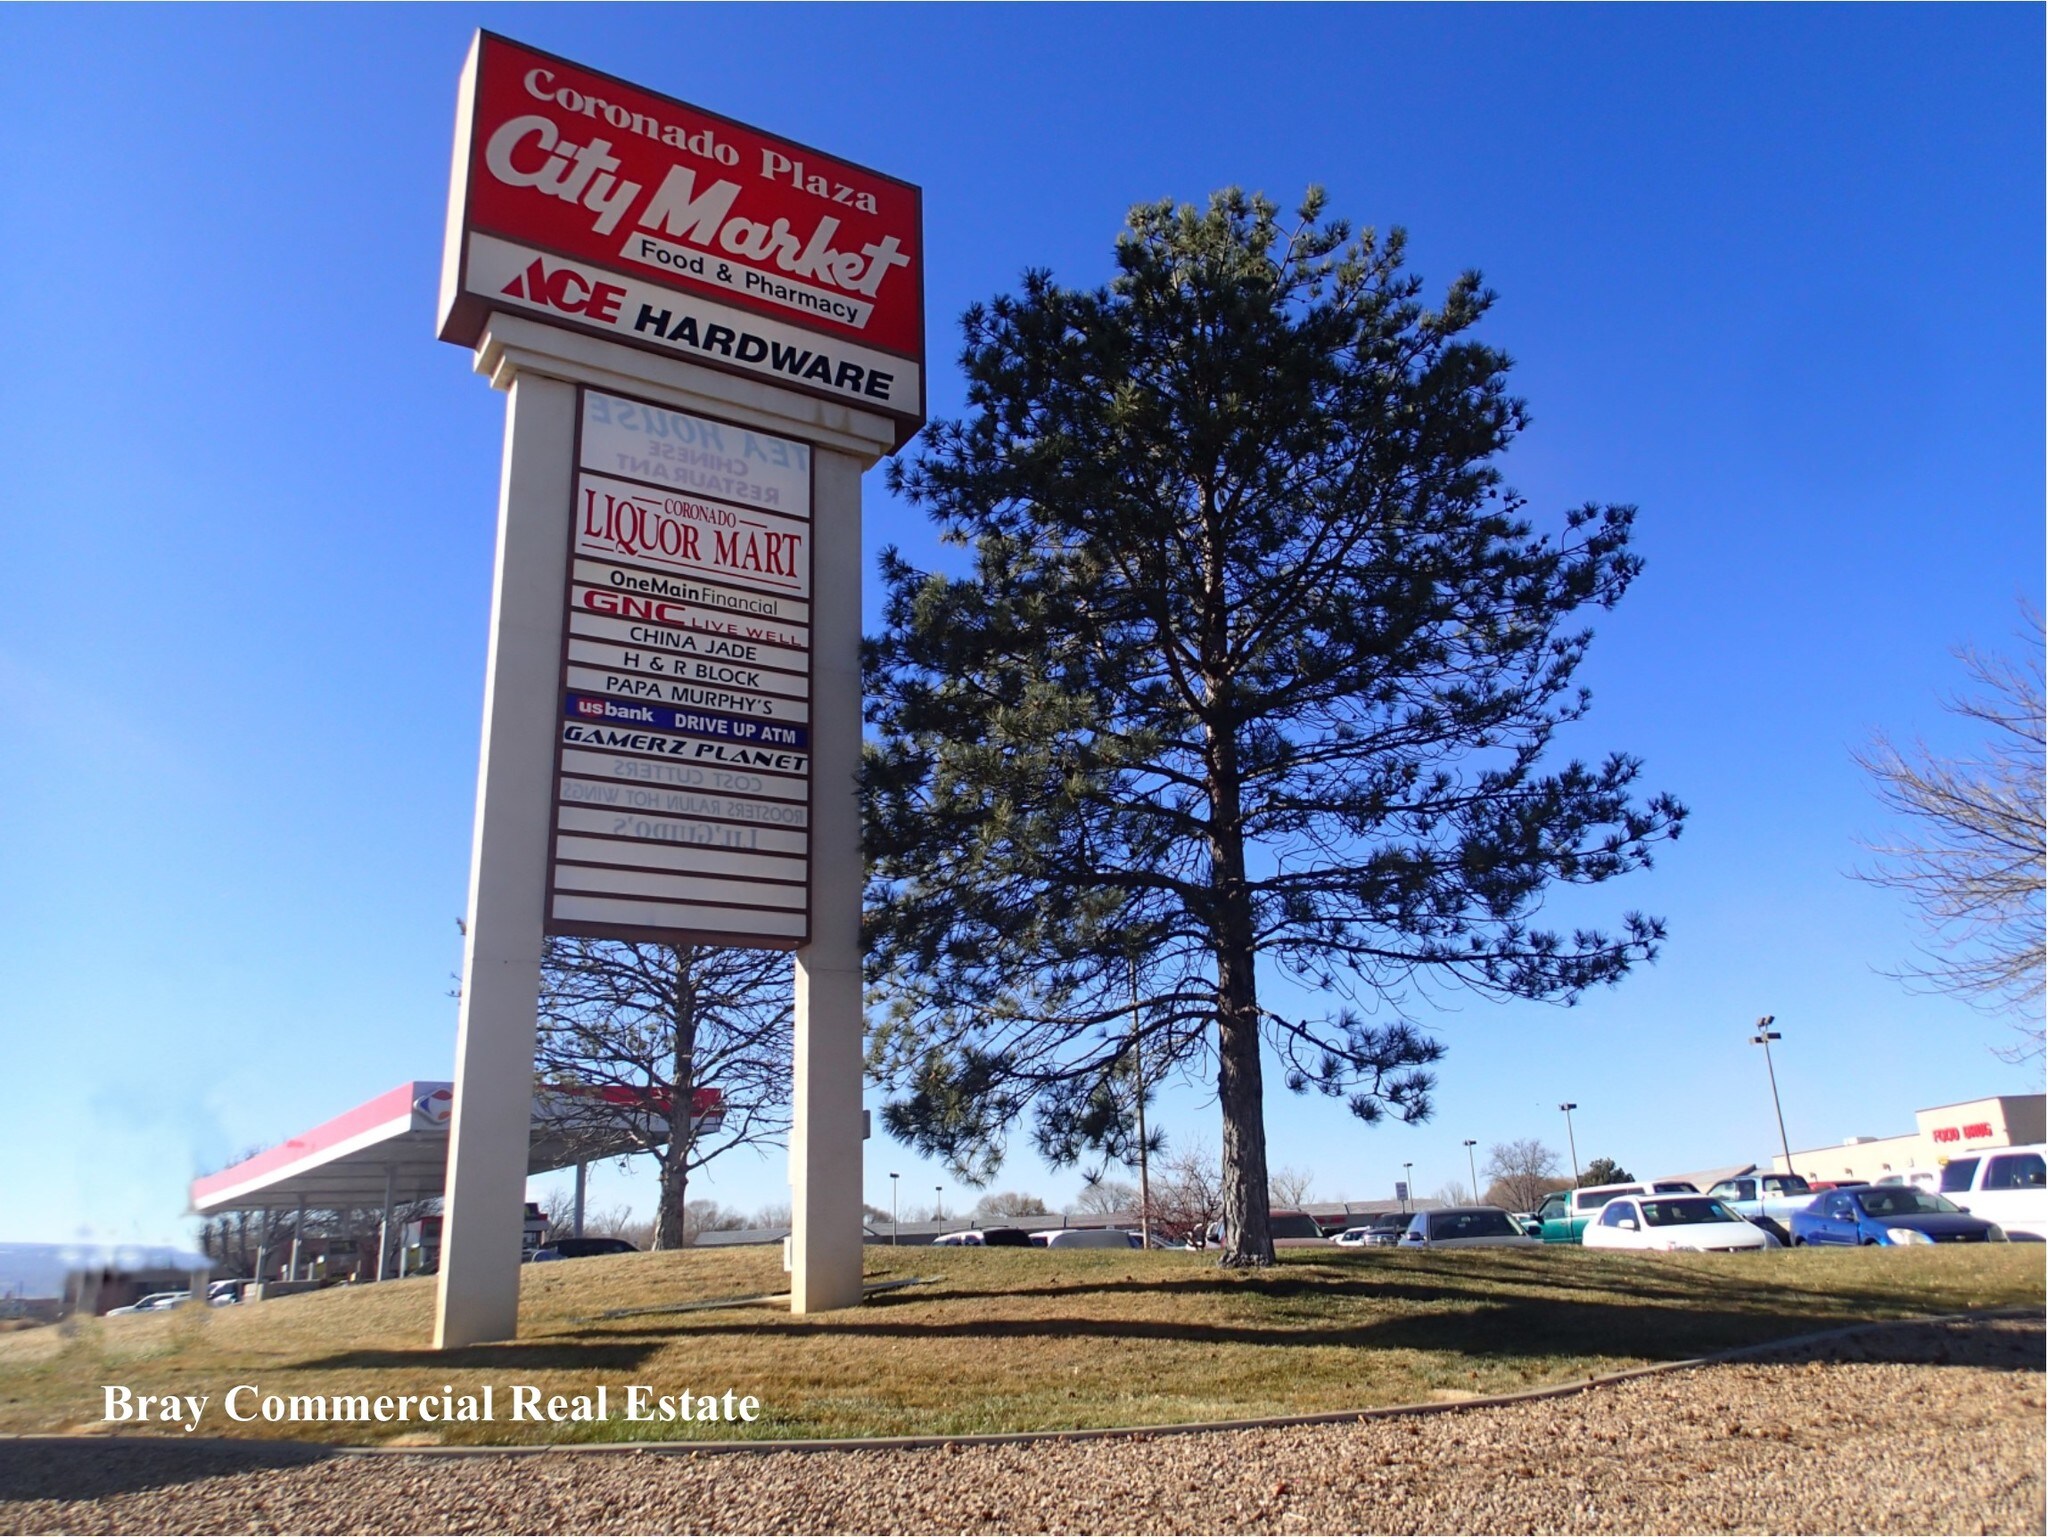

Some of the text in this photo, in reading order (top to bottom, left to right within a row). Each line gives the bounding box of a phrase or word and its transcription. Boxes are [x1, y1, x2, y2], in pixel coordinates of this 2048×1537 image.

[523, 68, 879, 215] Coronado Plaza
[485, 114, 911, 299] City Market
[640, 239, 859, 323] Food & Pharmacy
[501, 256, 895, 401] ACE HARDWARE
[584, 488, 802, 579] LIQUOR MART
[664, 498, 737, 529] CORONADO
[583, 590, 802, 647] GNC LIVE WELL
[630, 626, 757, 662] CHINA JADE
[624, 651, 760, 688] H & R BLOCK
[606, 676, 773, 715] PAPA MURPHY'S
[564, 725, 808, 771] GAMERZ PLANET
[675, 713, 728, 735] DRIVE
[733, 721, 757, 739] UP
[761, 726, 796, 745] ATM
